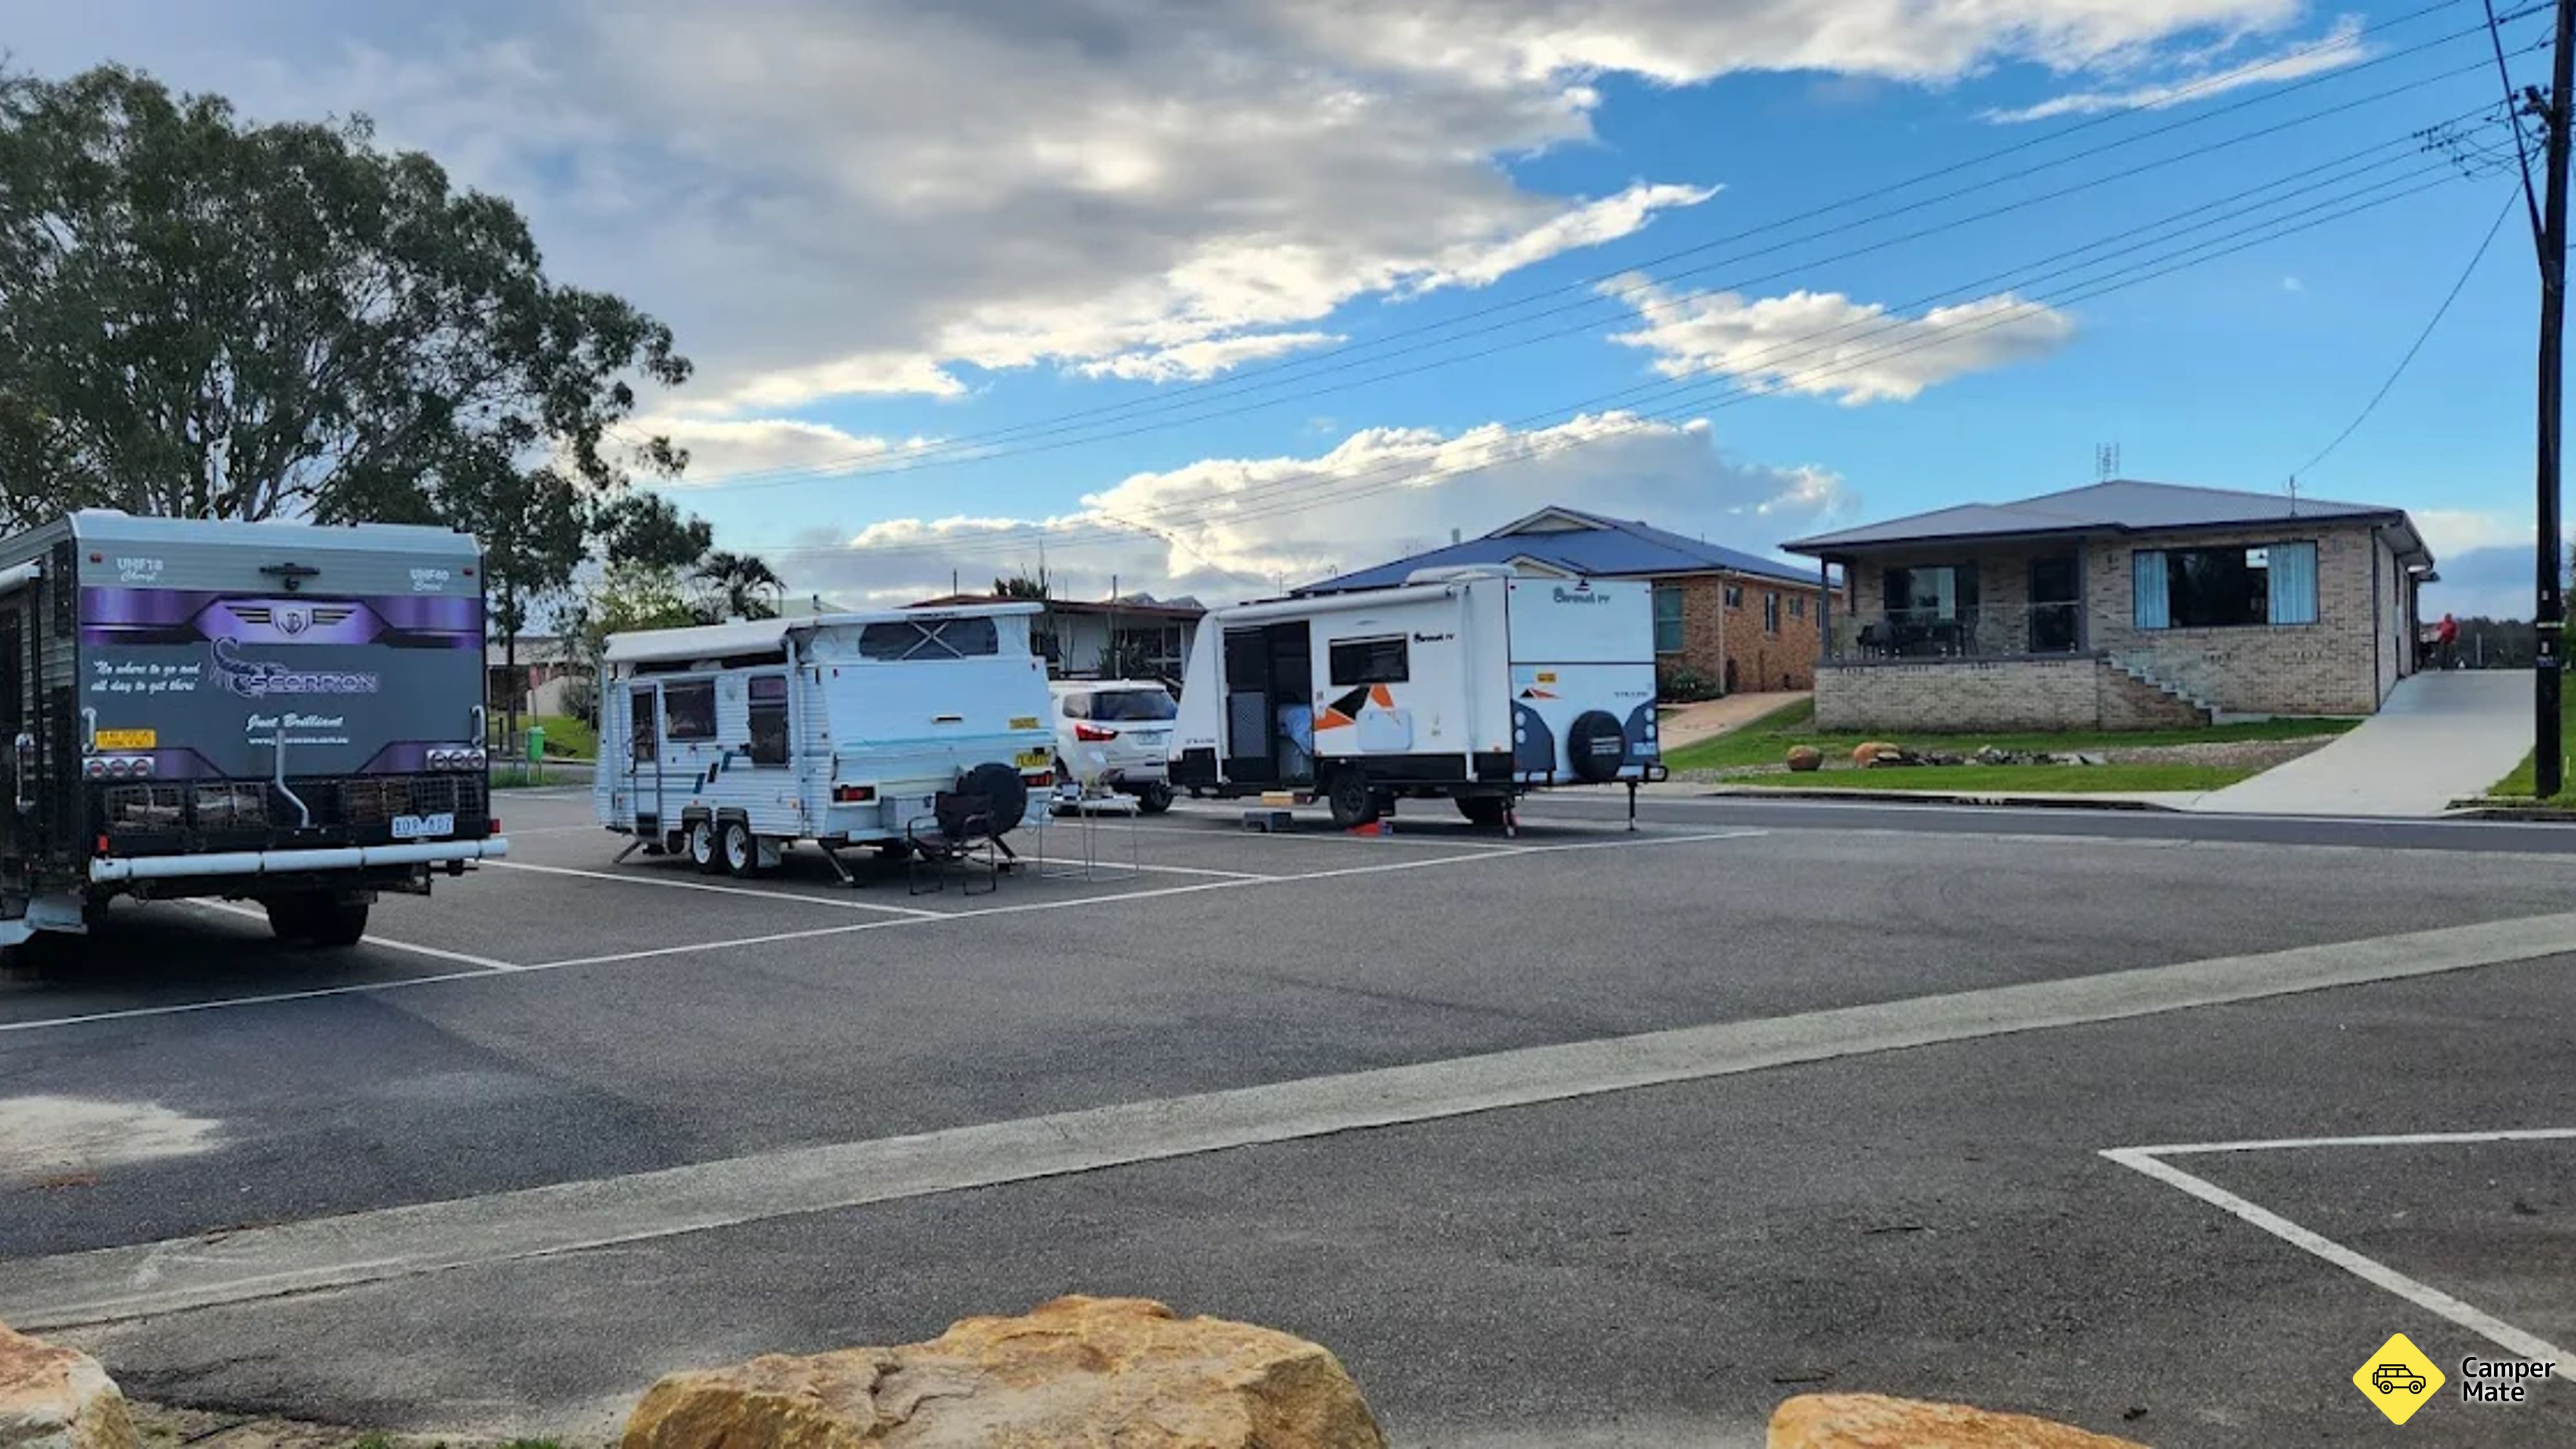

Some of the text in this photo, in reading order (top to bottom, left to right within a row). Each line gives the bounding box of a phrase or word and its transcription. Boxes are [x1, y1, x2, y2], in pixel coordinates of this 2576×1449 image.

[115, 661, 147, 674] where
[149, 664, 160, 674] to
[162, 666, 176, 677] go
[178, 662, 201, 674] and
[91, 679, 108, 691] all
[110, 680, 132, 694] day
[135, 681, 146, 691] to
[149, 680, 167, 695] get
[250, 673, 379, 693] SCORPION
[245, 713, 344, 732] Just Brilliant
